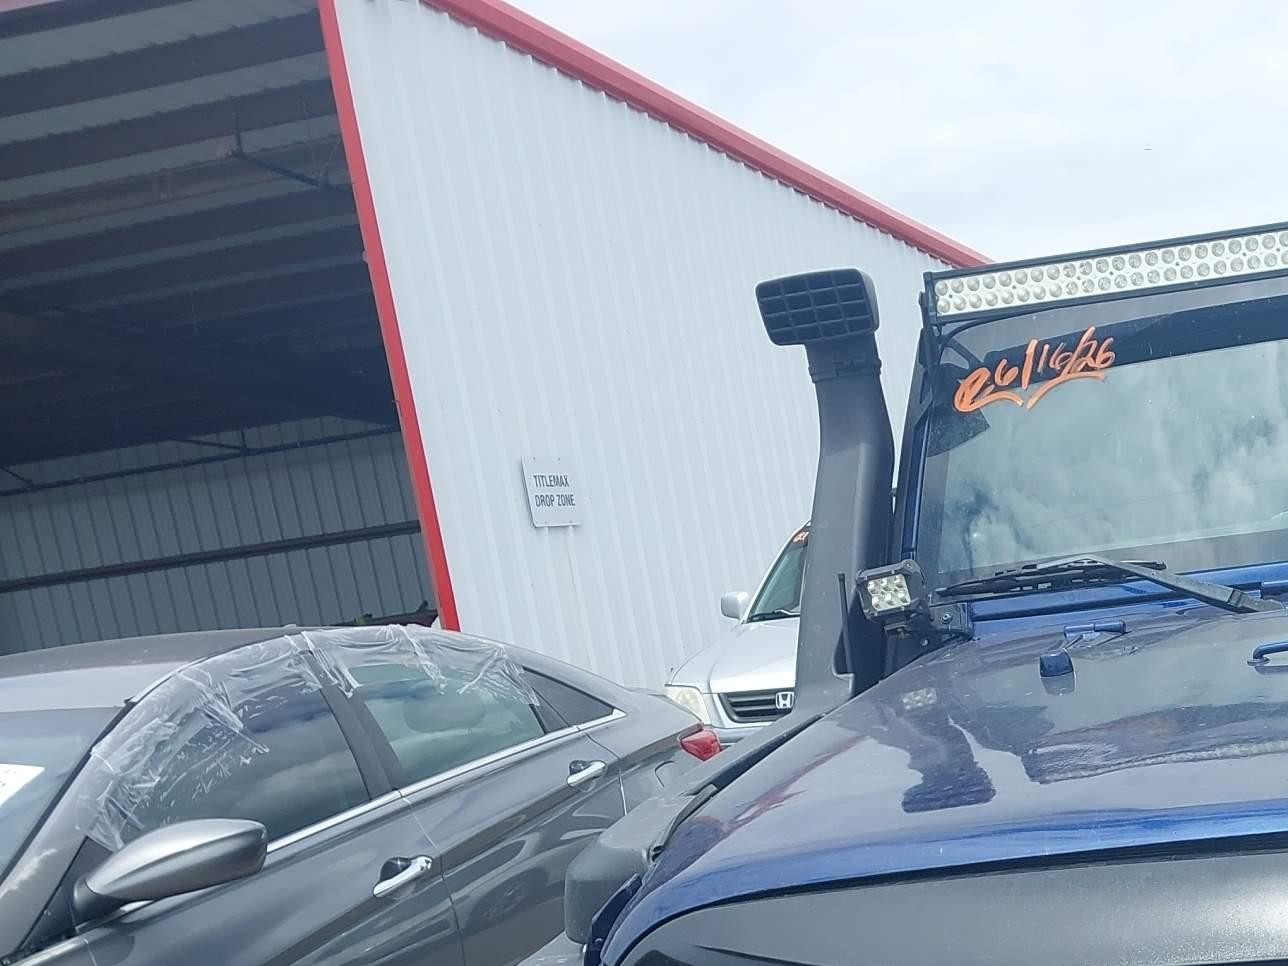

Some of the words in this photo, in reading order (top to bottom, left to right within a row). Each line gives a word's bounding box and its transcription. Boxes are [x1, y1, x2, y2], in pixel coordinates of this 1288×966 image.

[533, 474, 569, 488] TITLEMAX
[535, 494, 555, 507] DROP
[556, 494, 576, 507] ZONE
